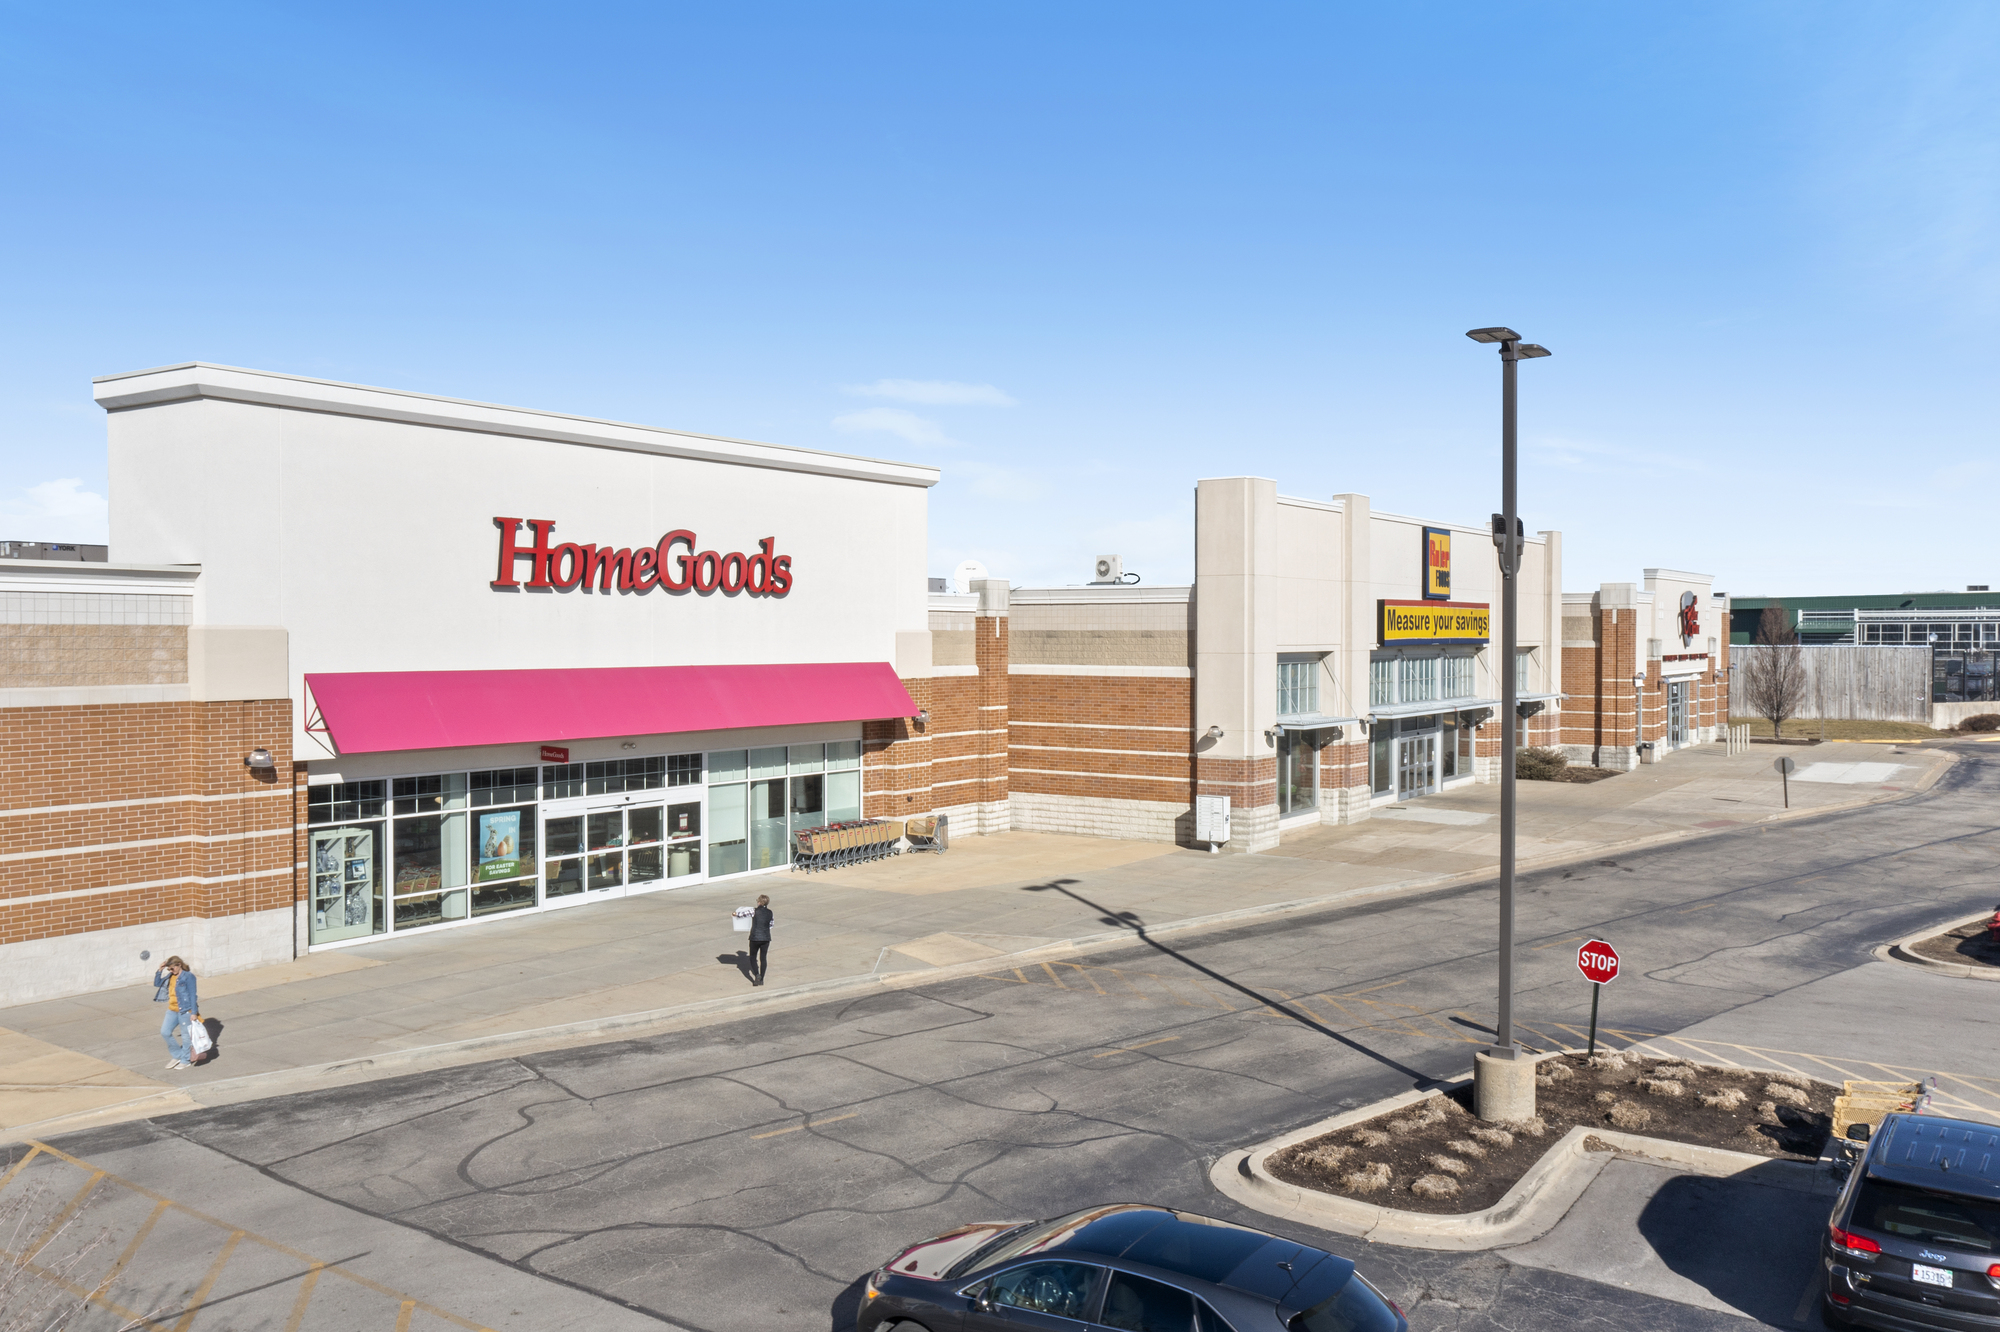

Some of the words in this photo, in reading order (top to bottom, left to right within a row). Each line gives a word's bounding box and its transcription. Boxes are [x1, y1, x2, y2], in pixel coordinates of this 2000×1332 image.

[491, 516, 793, 598] HomeGoods
[1387, 609, 1430, 631] Measure
[1433, 615, 1454, 636] your
[490, 815, 516, 824] SPRING
[1580, 950, 1617, 972] STOP
[1919, 1249, 1947, 1262] Jeep
